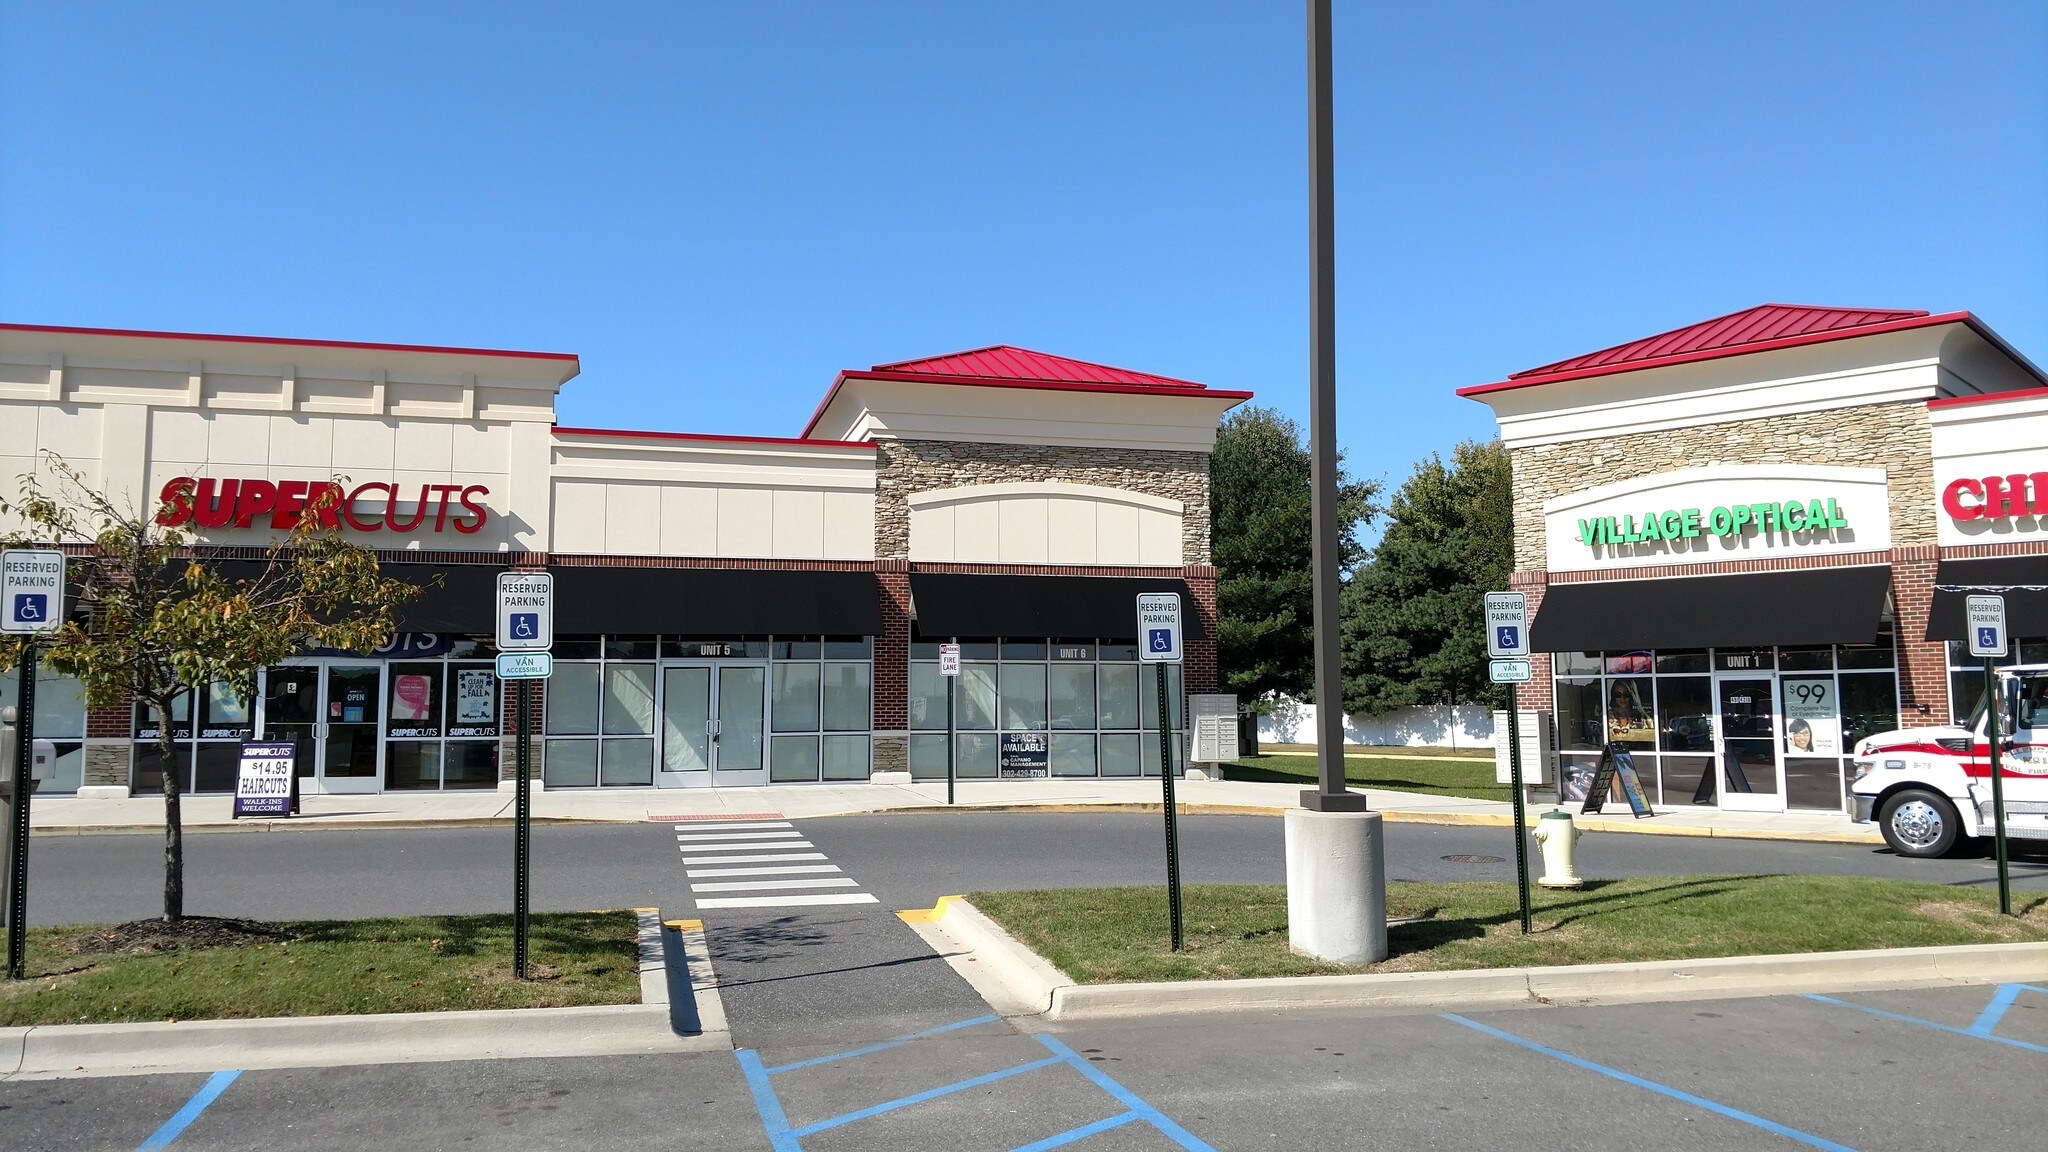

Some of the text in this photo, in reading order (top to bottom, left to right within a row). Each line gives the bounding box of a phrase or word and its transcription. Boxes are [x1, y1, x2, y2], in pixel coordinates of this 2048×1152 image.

[154, 476, 490, 534] SUPERCUTS
[1577, 498, 1847, 546] VILLAGE OPTICAL
[5, 562, 59, 573] RESERVED
[8, 576, 55, 587] PARKING
[502, 583, 548, 593] RESERVED
[505, 597, 545, 606] PARKING
[1488, 601, 1523, 610] RESERVED
[1141, 603, 1177, 612] RESERVED
[1970, 604, 2001, 612] RESERVED
[1143, 614, 1176, 623] PARKING
[1491, 612, 1522, 621] PARKING
[1972, 614, 2000, 623] PARKING
[700, 645, 730, 656] UNIT 5
[1060, 648, 1086, 658] UNIT 6
[1727, 656, 1759, 667] UNIT 1
[506, 666, 543, 674] ACCESSIBLE
[347, 693, 365, 701] OPEN
[467, 689, 484, 697] FALL
[1789, 684, 1826, 704] $99
[202, 729, 251, 738] SUPERCU
[391, 728, 438, 736] SUPERCUTS
[449, 727, 496, 736] SUPERCUTS
[1010, 734, 1037, 742] SPACE
[243, 748, 291, 756] SUPERCUTS
[1002, 743, 1047, 752] AVAILABLE
[252, 761, 288, 775] $14.95
[1002, 769, 1046, 778] 302-429-8700
[241, 778, 288, 794] HAIRCUTS
